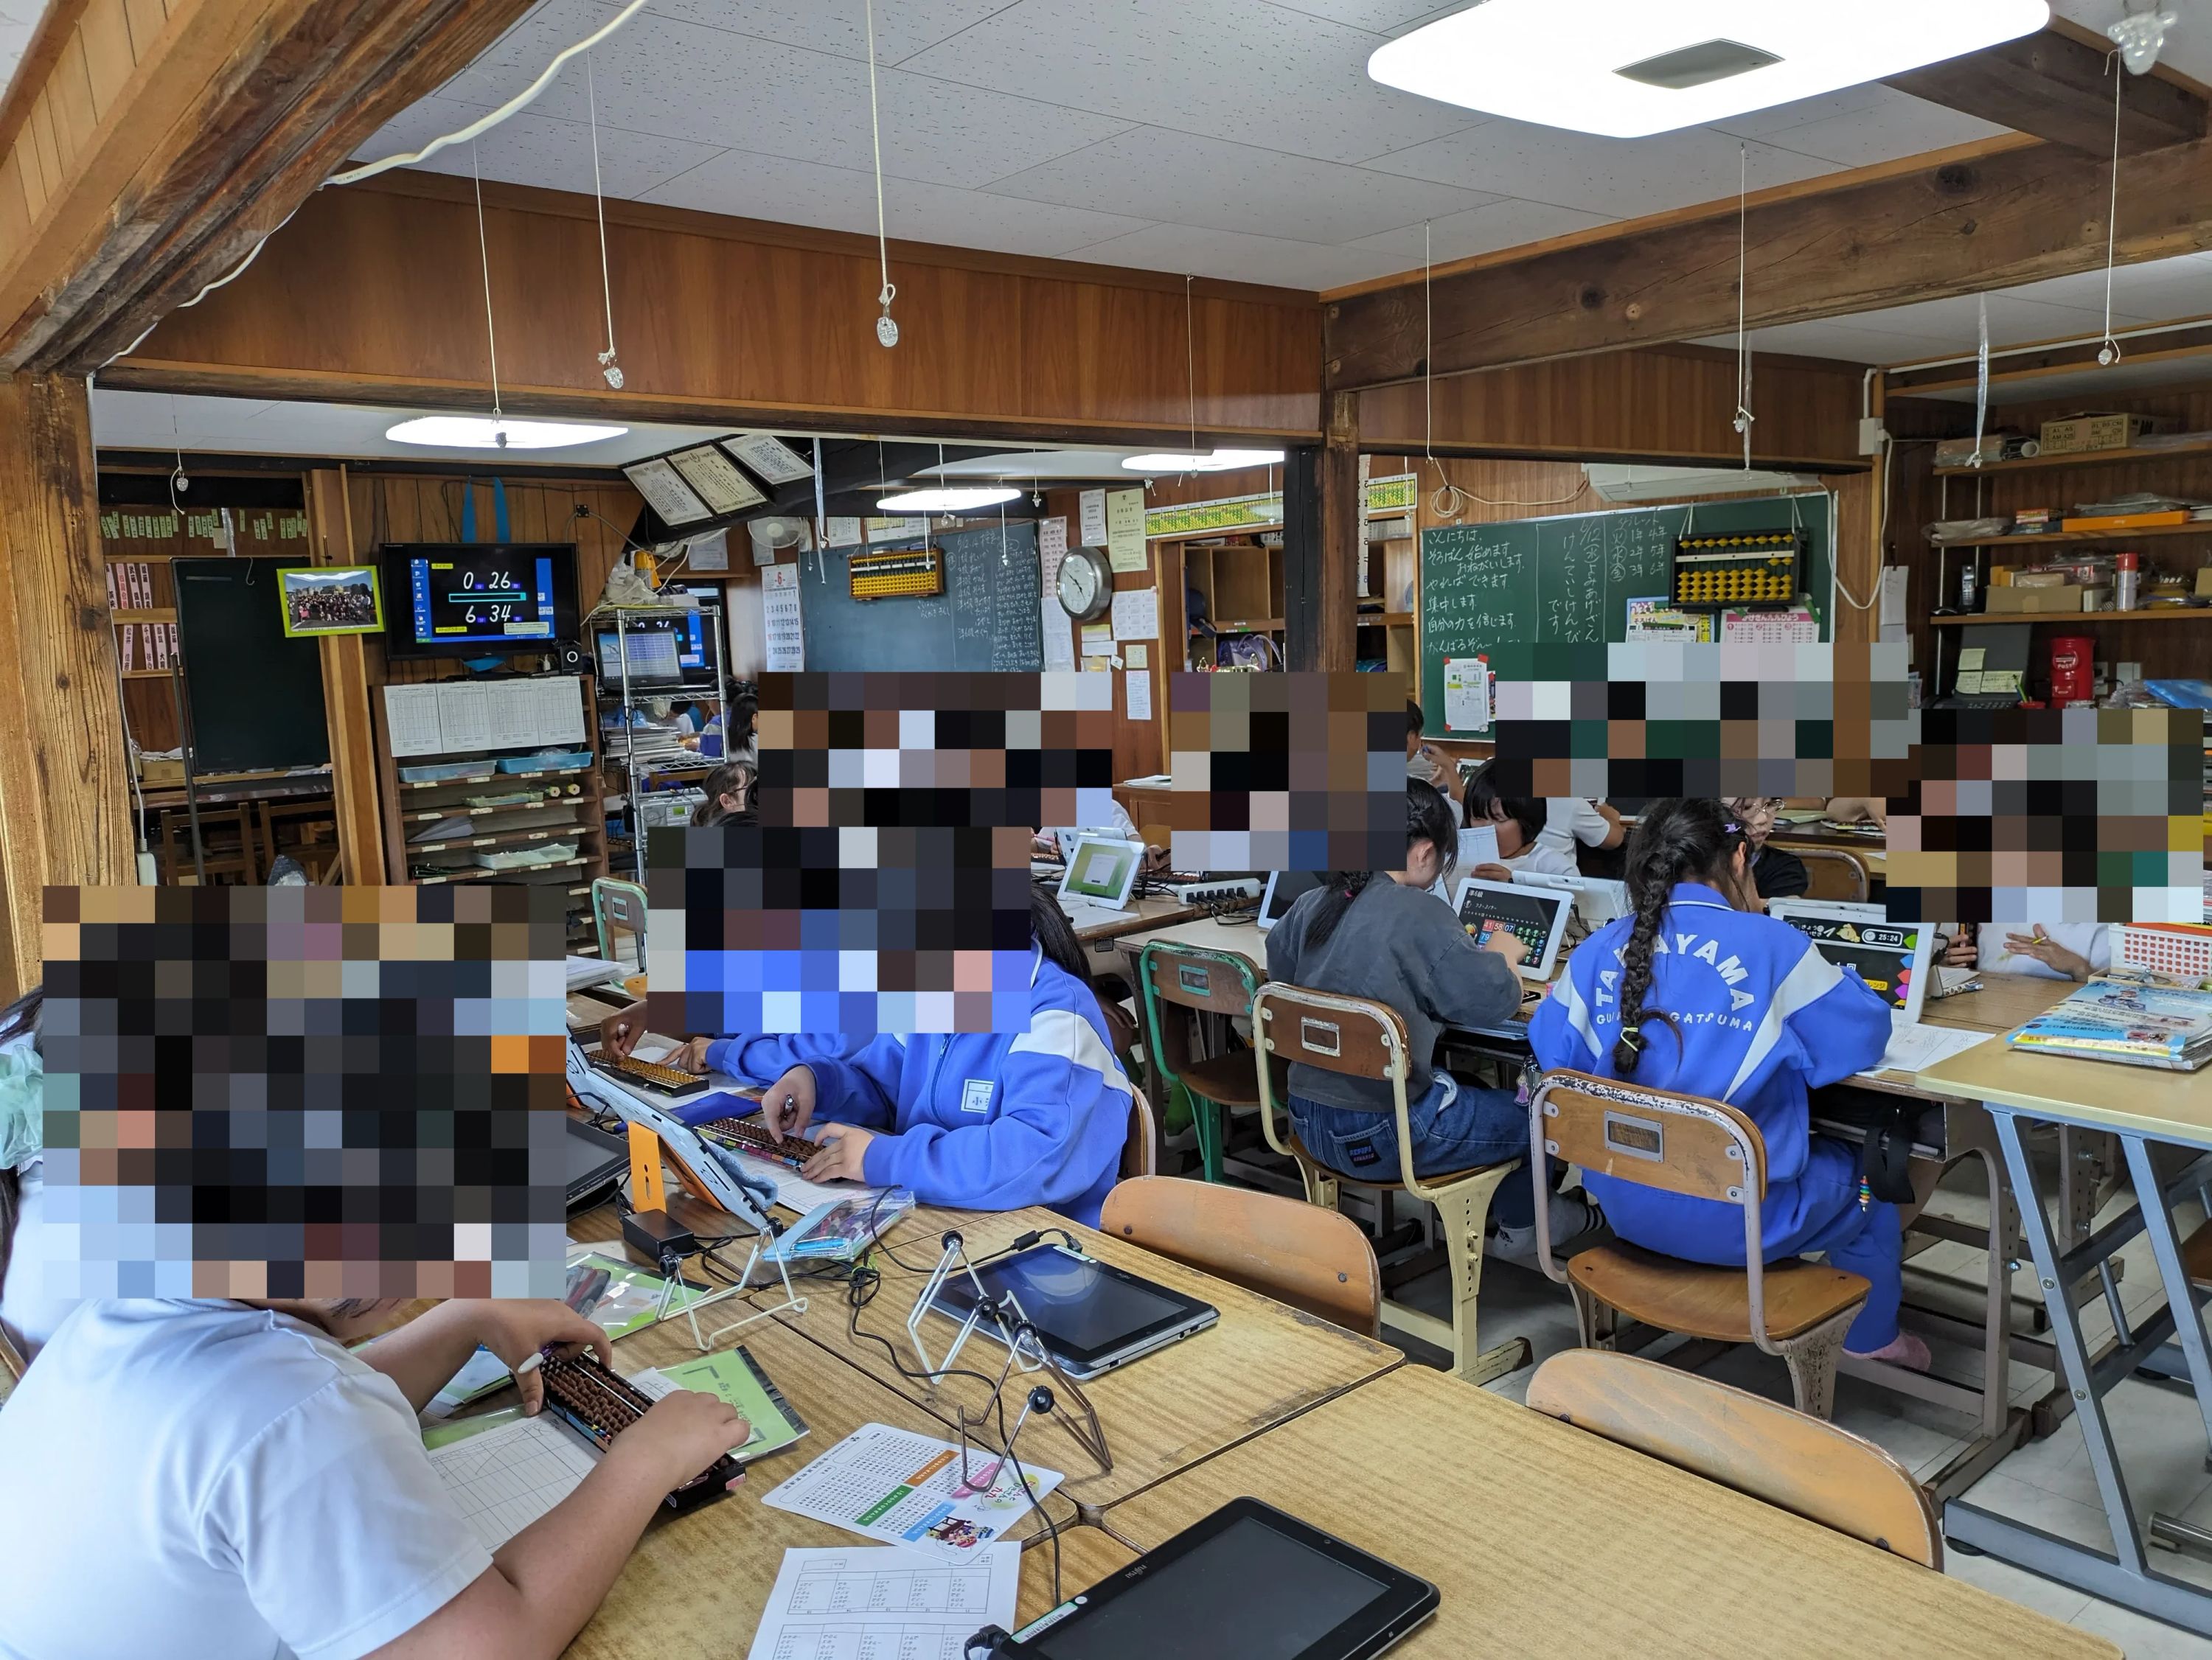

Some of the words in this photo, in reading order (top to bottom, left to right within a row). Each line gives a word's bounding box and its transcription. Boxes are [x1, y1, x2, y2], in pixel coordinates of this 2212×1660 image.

[463, 572, 474, 589] 0
[488, 571, 511, 589] 26
[777, 571, 782, 585] 6
[465, 606, 476, 623] 6
[489, 605, 511, 622] 34
[1480, 932, 1489, 941] 79
[1878, 933, 1898, 942] 25:24
[1663, 1012, 1753, 1031] GATSUMA
[983, 1486, 1005, 1499] 九九
